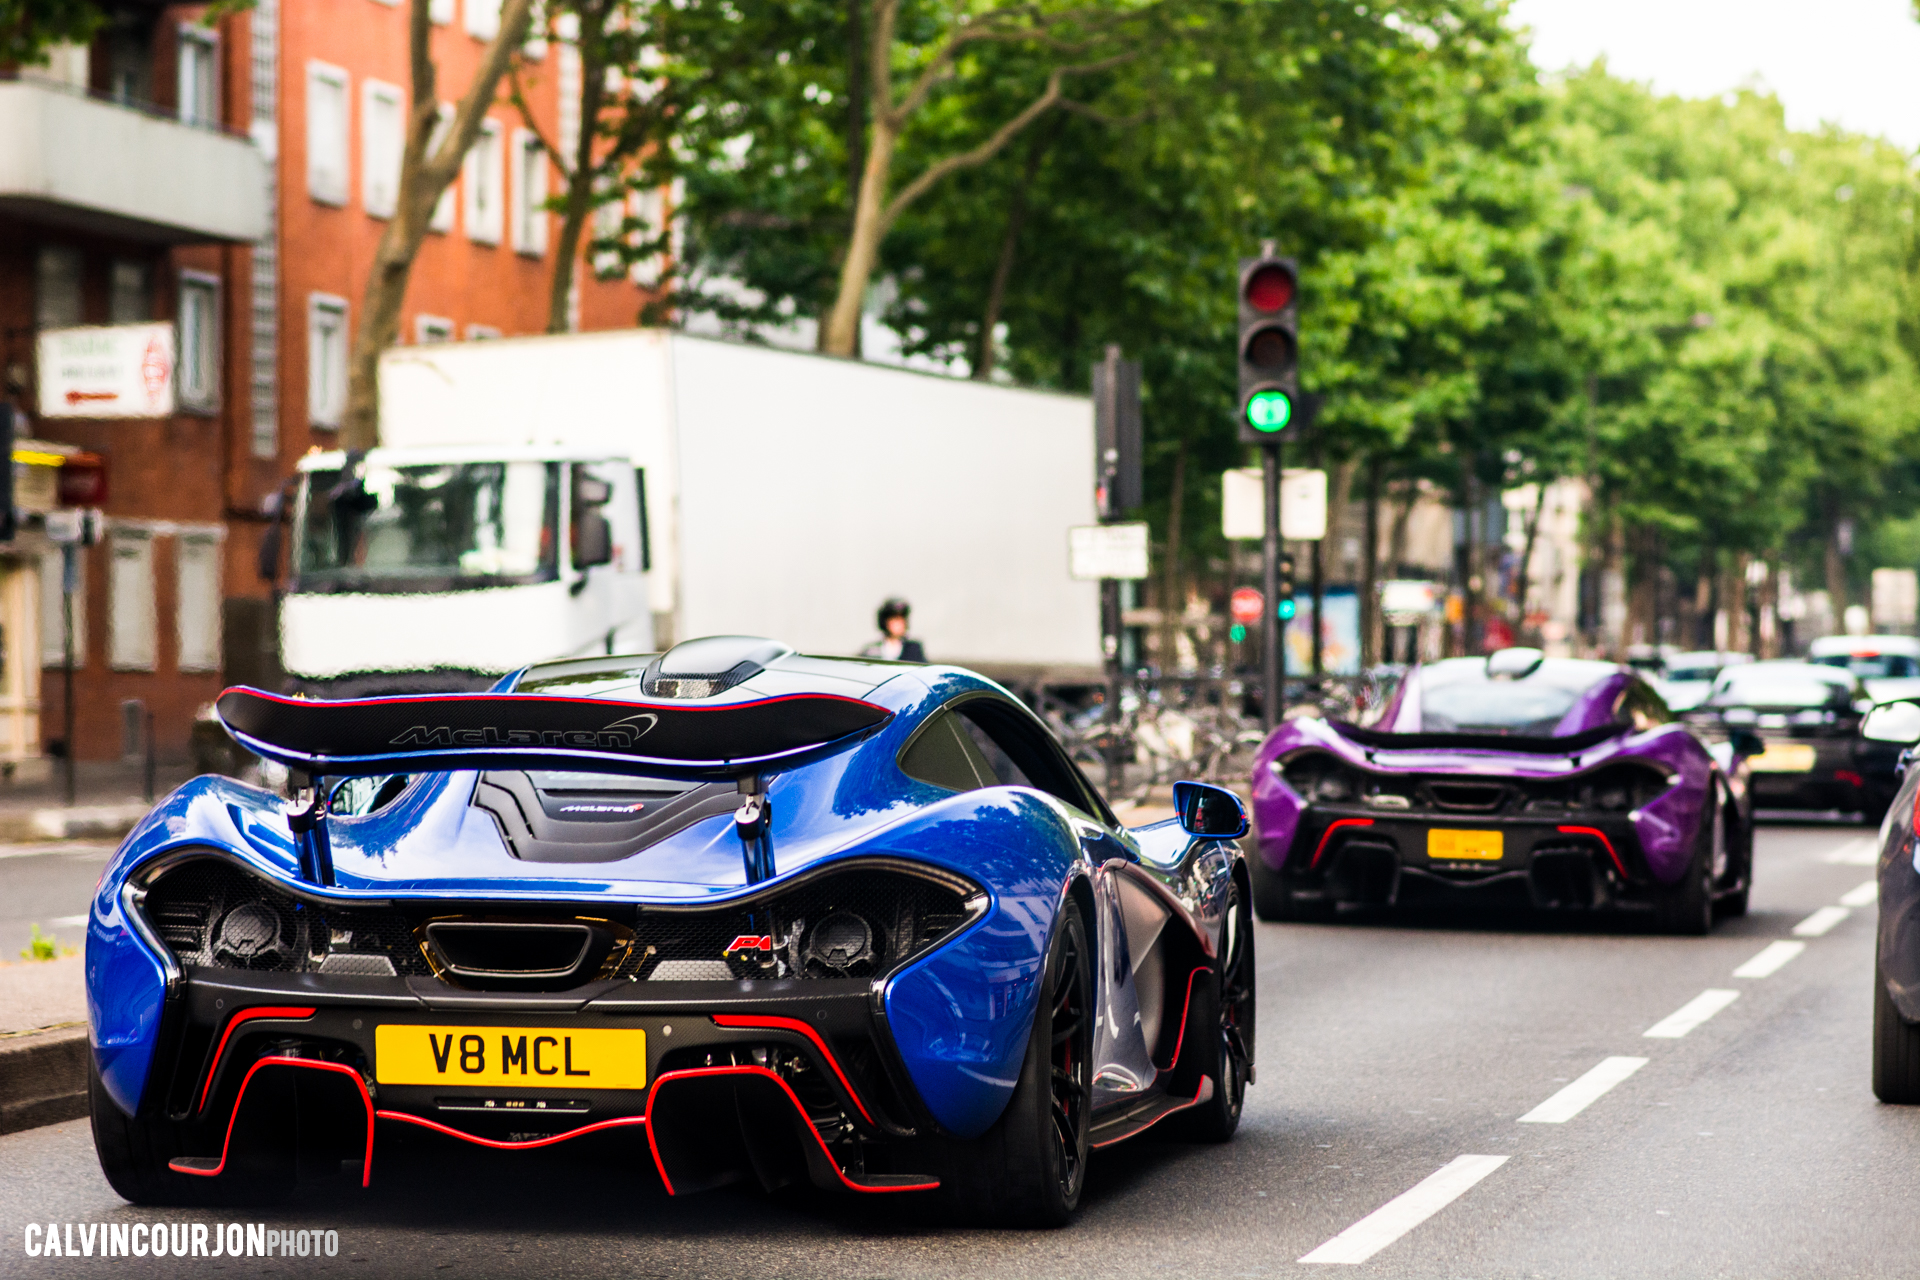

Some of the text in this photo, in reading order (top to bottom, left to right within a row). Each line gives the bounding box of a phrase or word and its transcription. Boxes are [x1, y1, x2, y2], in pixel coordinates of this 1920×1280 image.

[388, 725, 633, 748] McLaren
[726, 934, 772, 952] P1
[428, 1033, 592, 1077] V8 MCL
